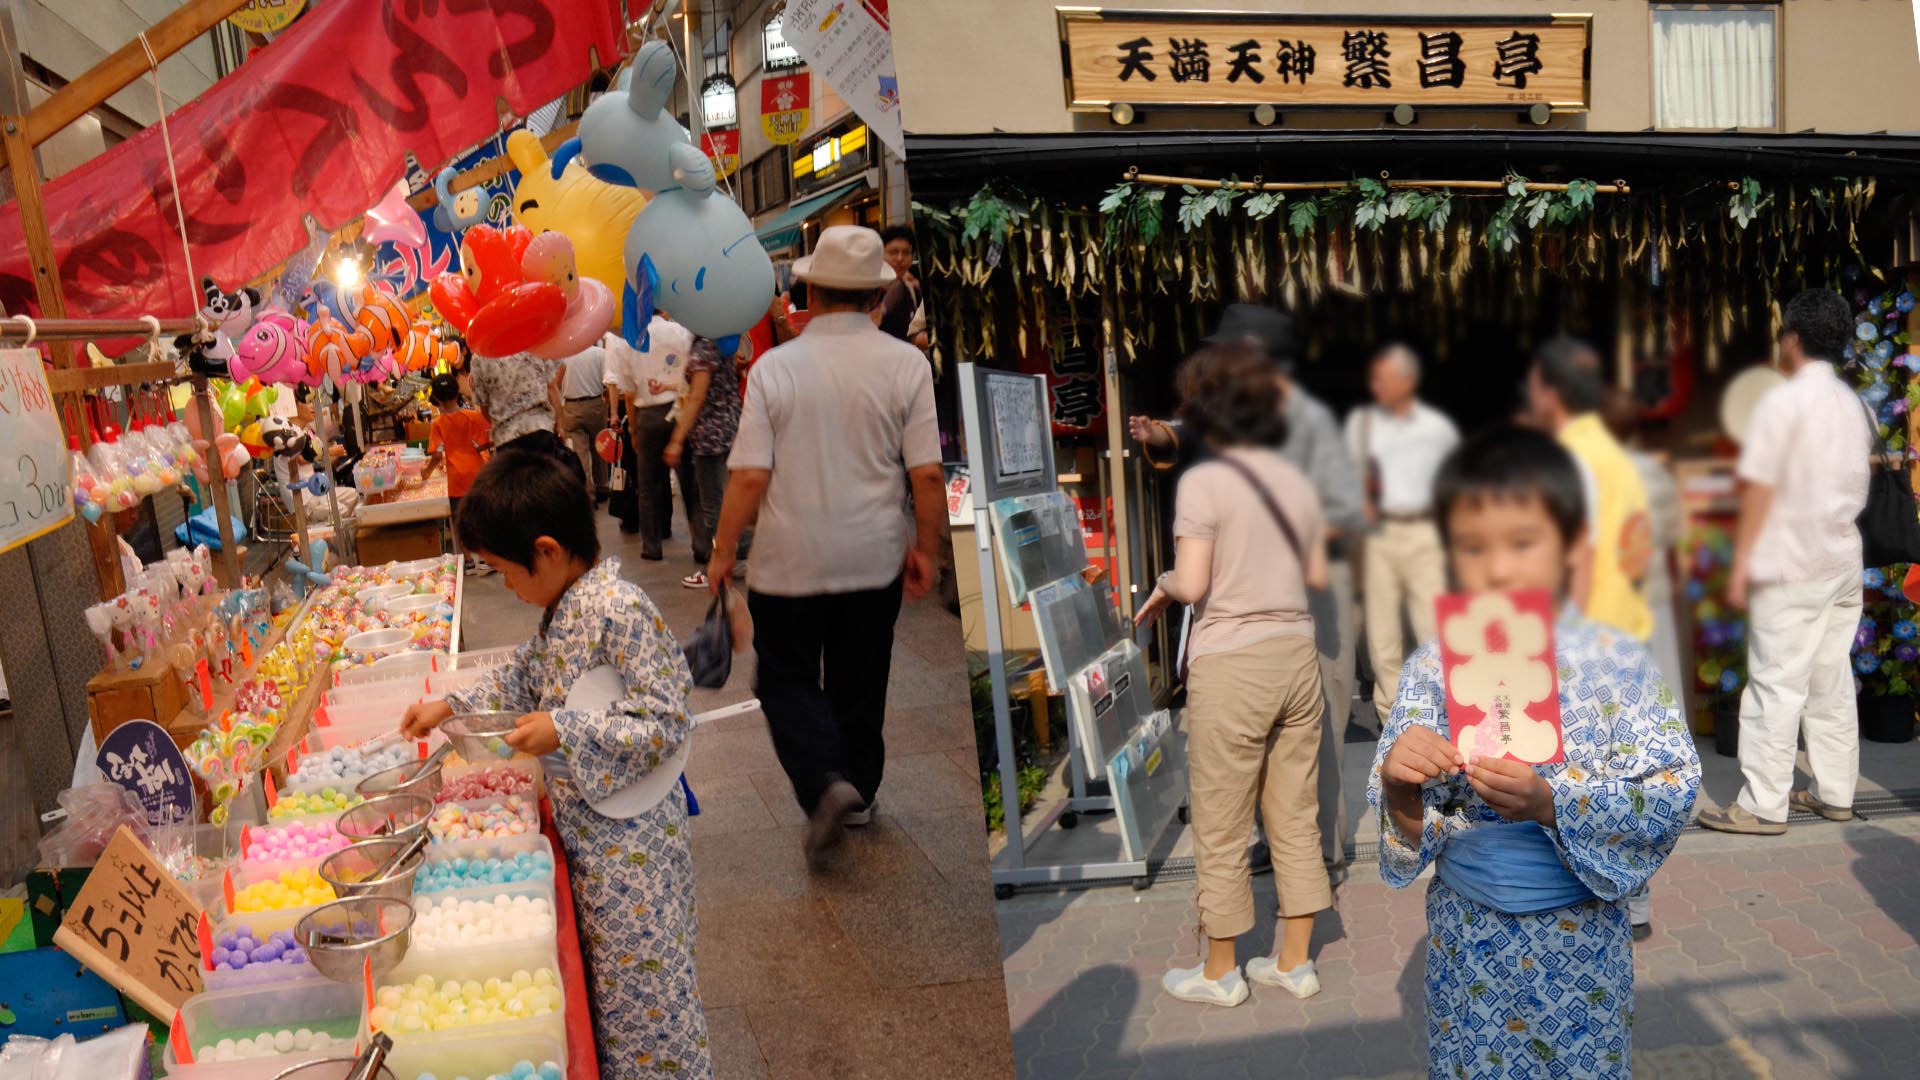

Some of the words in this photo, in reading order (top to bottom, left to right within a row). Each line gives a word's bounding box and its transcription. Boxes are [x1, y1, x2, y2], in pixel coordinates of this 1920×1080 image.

[1116, 30, 1544, 90] 天満天神繁昌亭
[1498, 709, 1512, 745] 繁昌亭
[82, 863, 161, 962] 5コ以上
